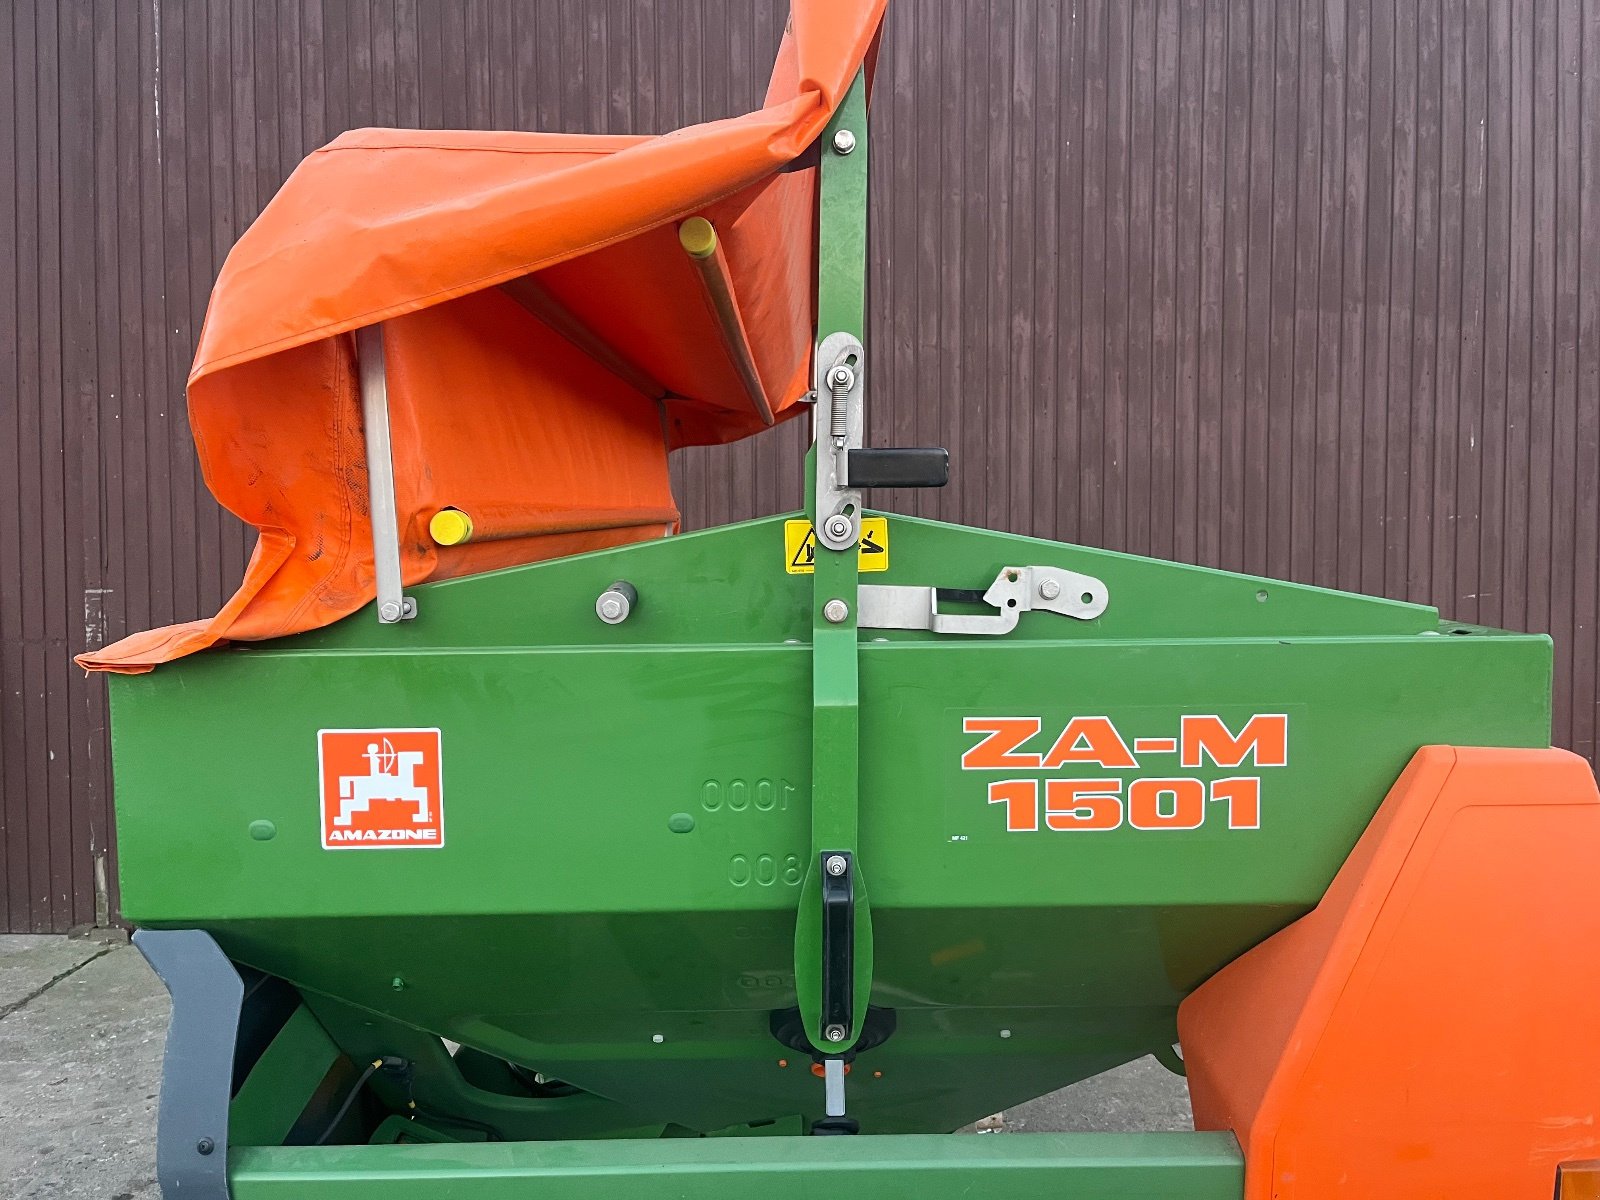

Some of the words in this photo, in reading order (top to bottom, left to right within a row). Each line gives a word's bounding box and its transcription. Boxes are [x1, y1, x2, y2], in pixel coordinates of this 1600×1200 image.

[961, 713, 1288, 771] ZA-M
[987, 776, 1261, 832] 1501
[328, 828, 437, 841] AMAZONE
